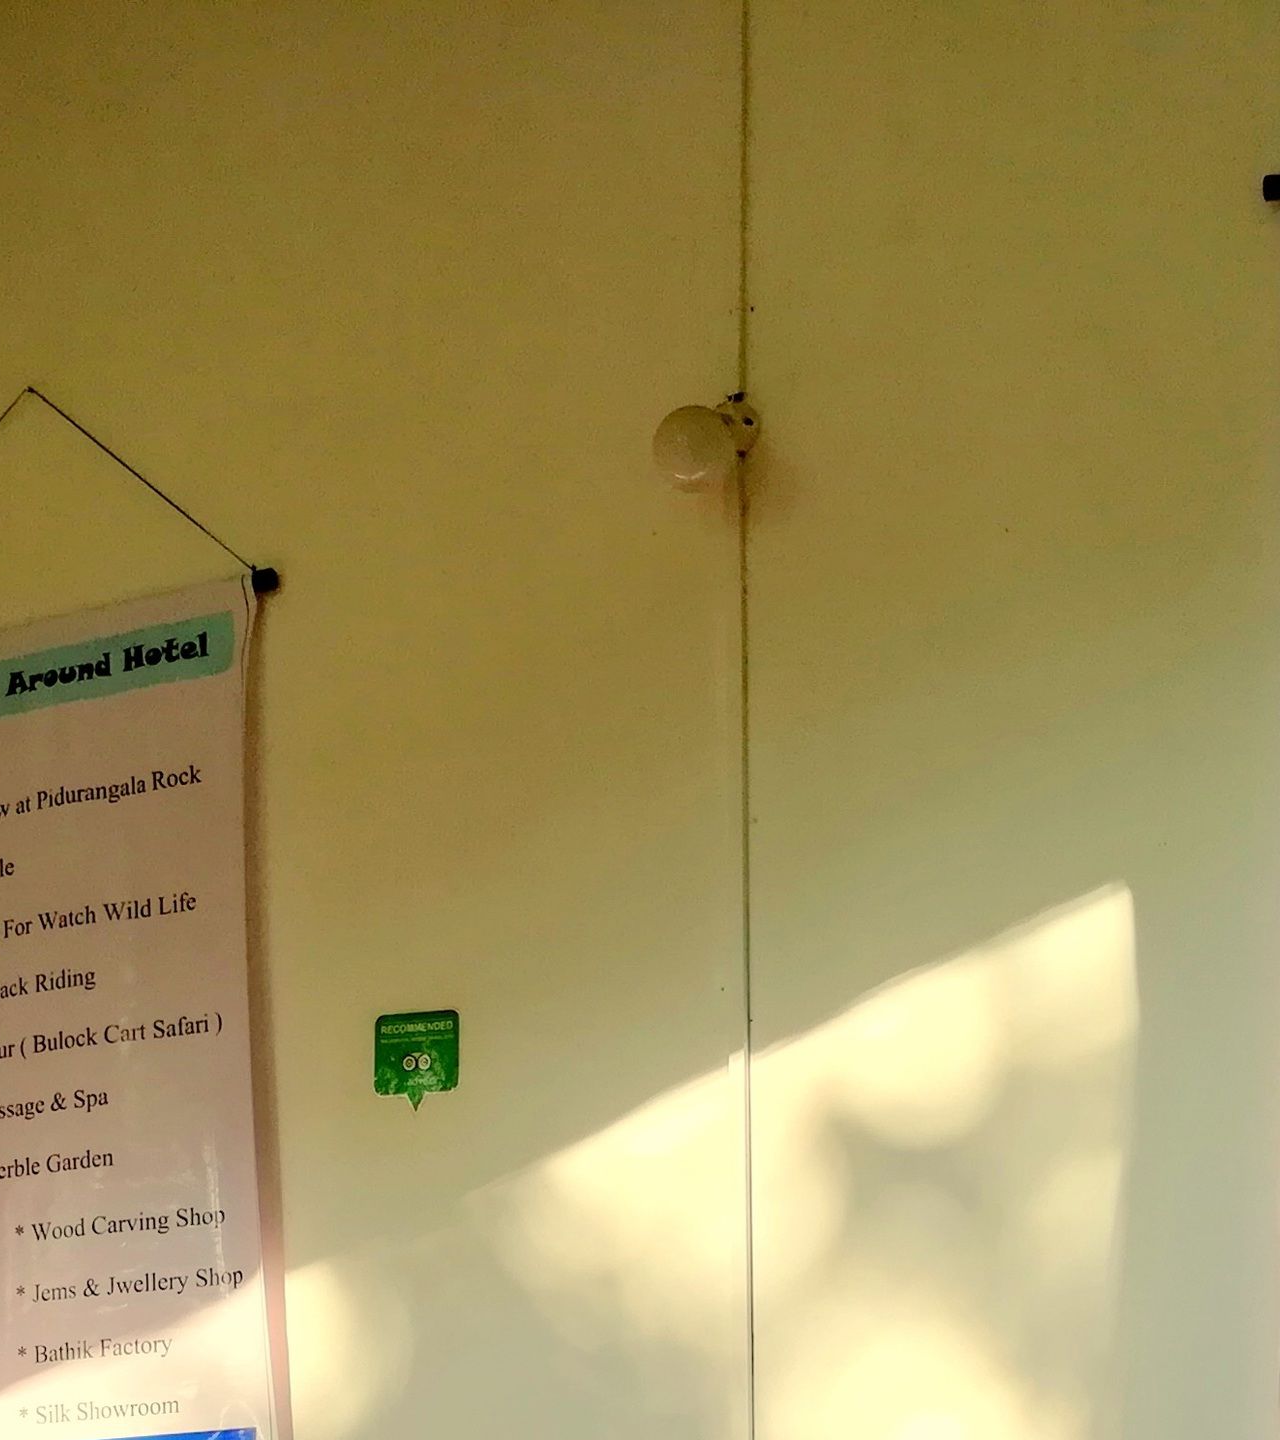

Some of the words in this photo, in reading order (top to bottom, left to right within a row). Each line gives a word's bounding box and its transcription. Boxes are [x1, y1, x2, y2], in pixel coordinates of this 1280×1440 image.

[6, 652, 112, 696] Around
[123, 632, 209, 671] Hotel
[15, 797, 32, 816] at
[36, 776, 148, 811] Pidurangala
[151, 765, 202, 791] Rock
[3, 917, 33, 939] For
[38, 906, 97, 932] Watch
[103, 900, 152, 922] Wild
[158, 892, 197, 914] Life
[35, 968, 97, 994] Riding
[32, 1027, 98, 1054] Bulock
[103, 1023, 147, 1045] Cart
[152, 1015, 209, 1039] Safari
[381, 1021, 453, 1034] RECOMMENDED
[50, 1093, 68, 1112] &
[73, 1089, 109, 1113] Spa
[45, 1149, 115, 1173] Garden
[31, 1218, 86, 1242] Wood
[91, 1209, 169, 1236] Carving
[176, 1205, 226, 1229] Shop
[32, 1282, 77, 1303] Jems
[83, 1278, 100, 1297] &
[106, 1268, 189, 1296] Jwellery
[195, 1265, 244, 1289] Shop
[34, 1340, 94, 1364] Bathik
[100, 1335, 173, 1359] Factory
[35, 1404, 71, 1426] Silk
[76, 1397, 180, 1422] Showroom
